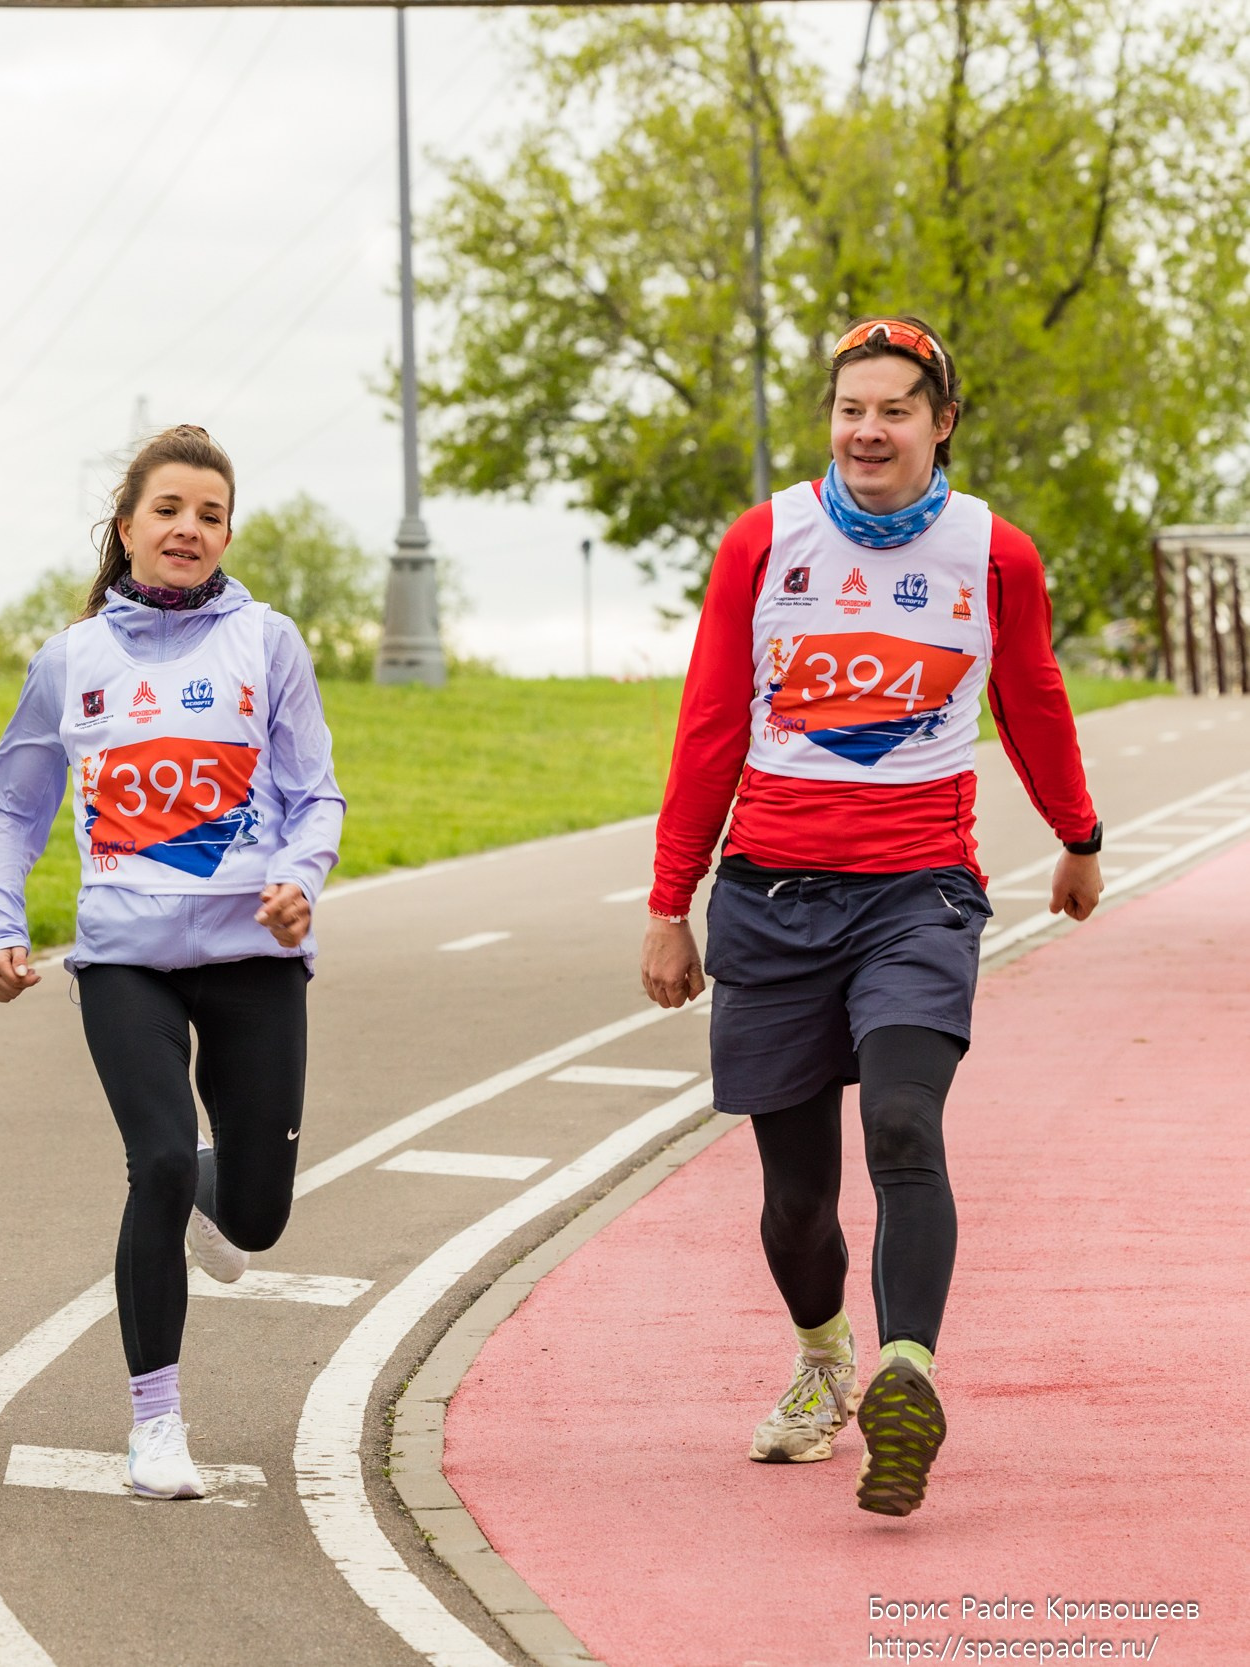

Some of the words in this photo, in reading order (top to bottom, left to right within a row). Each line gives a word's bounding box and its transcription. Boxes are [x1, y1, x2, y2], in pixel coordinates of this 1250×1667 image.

[801, 652, 925, 712] 394
[111, 759, 222, 818] 395
[92, 855, 118, 874] ГТО
